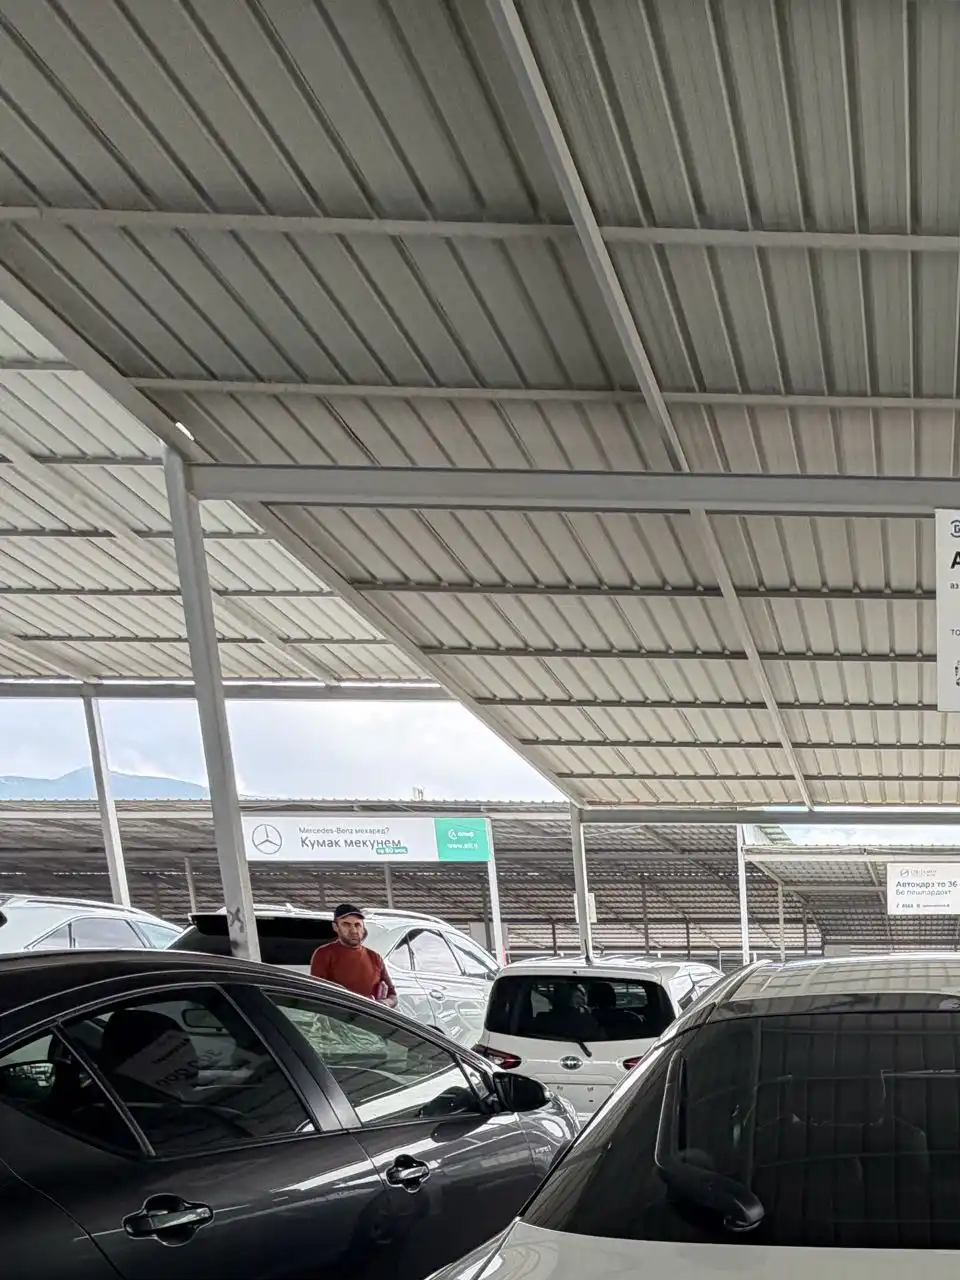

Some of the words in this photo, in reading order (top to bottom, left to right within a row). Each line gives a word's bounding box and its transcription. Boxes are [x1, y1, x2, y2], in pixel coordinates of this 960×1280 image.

[299, 826, 354, 835] Mercedes-Benz
[300, 836, 341, 851] Кумак
[344, 838, 402, 851] мекунем
[947, 880, 958, 888] 36
